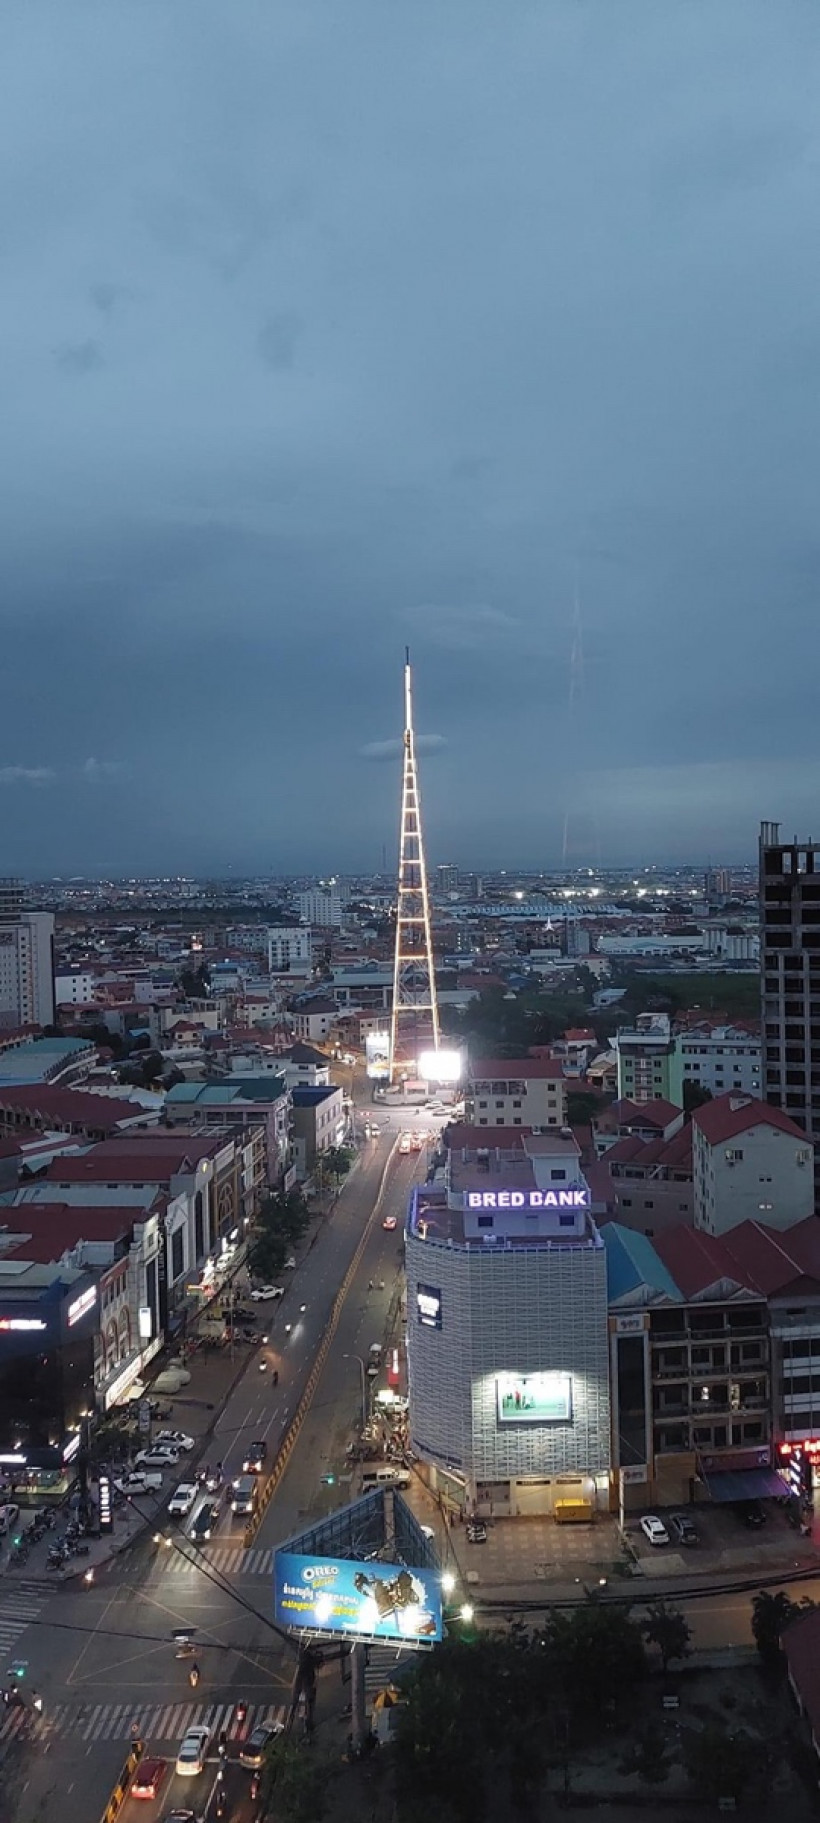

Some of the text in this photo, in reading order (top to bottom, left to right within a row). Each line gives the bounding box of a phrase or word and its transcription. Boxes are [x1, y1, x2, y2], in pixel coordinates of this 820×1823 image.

[468, 1191, 587, 1207] BRED BANK
[302, 1566, 339, 1581] OREO
